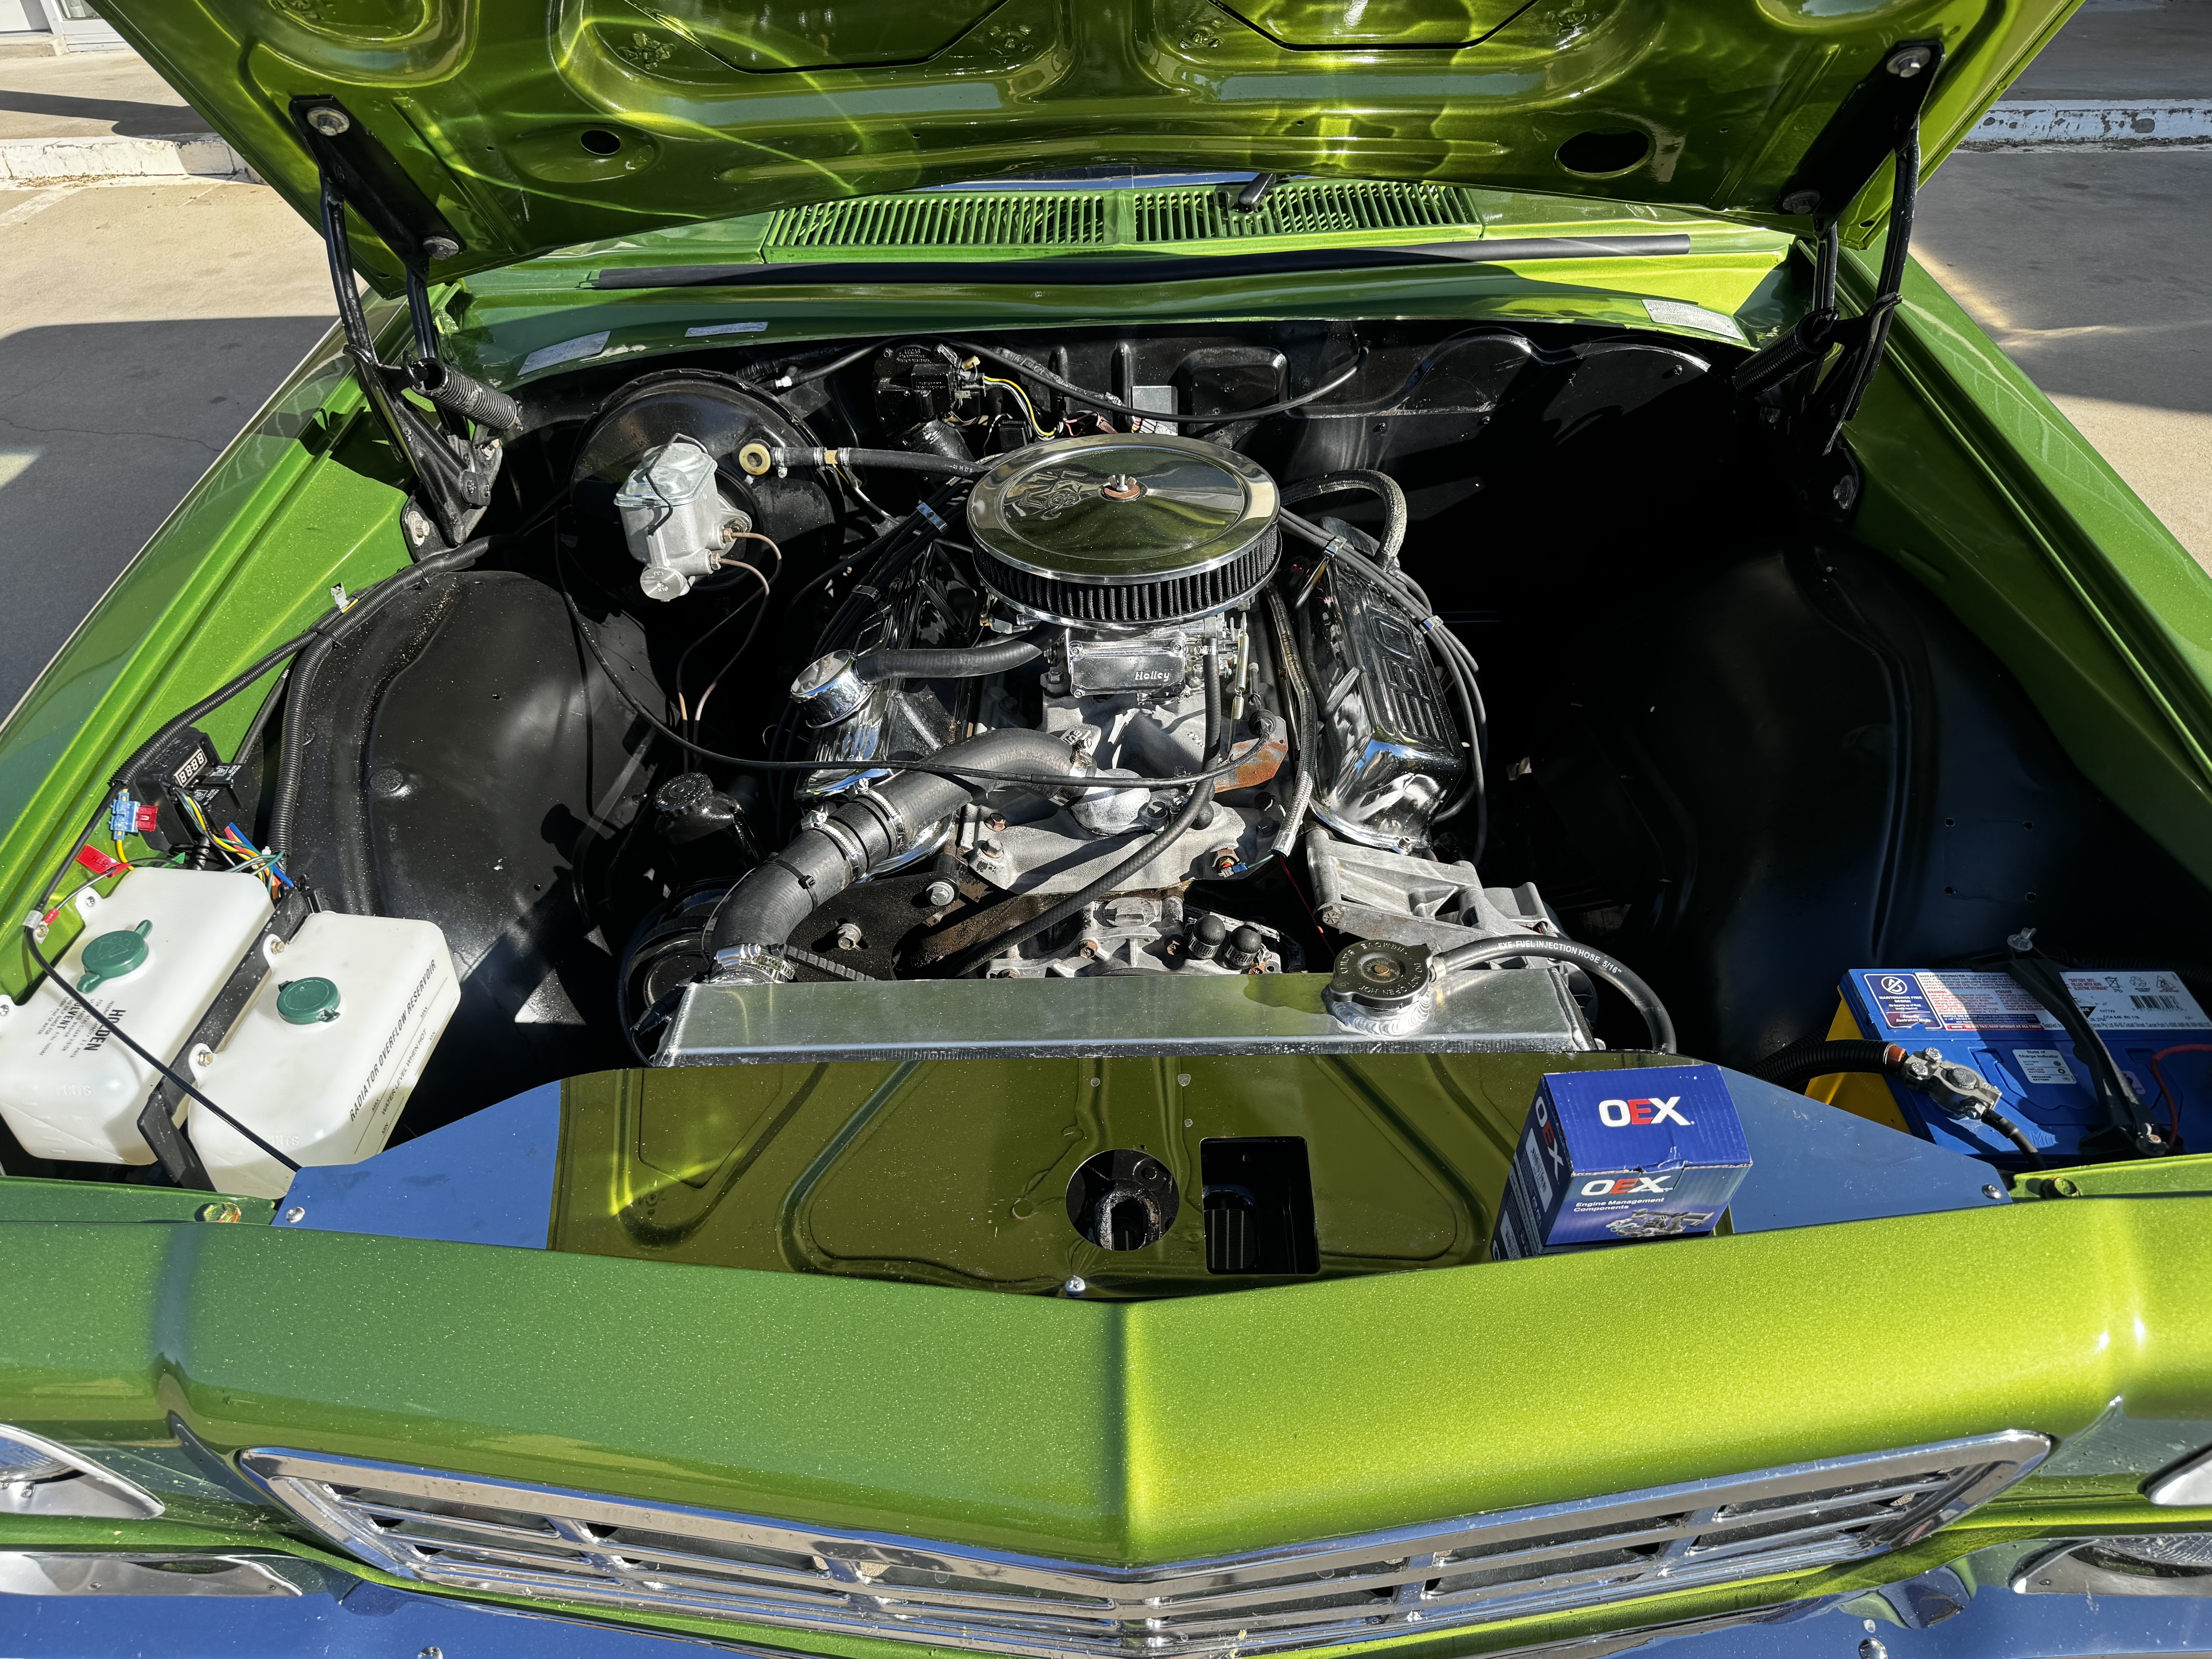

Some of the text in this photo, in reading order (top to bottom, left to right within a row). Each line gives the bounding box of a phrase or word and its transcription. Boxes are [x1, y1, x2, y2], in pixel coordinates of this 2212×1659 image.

[1135, 671, 1170, 682] Holley
[1536, 940, 1577, 955] INJECTION
[1578, 949, 1601, 963] HOSE
[1408, 975, 1421, 988] NOT
[1359, 986, 1379, 994] HOT
[1383, 986, 1407, 995] OPEN
[57, 1002, 82, 1030] OLVENT
[64, 1022, 78, 1037] WASHER
[73, 1025, 84, 1038] CLEAR
[350, 959, 436, 1121] RADIATOR OVERFLOW RESERVOIR
[382, 1028, 427, 1115] WATER LEVEL WHEN HOT
[372, 1097, 380, 1112] MAX
[1599, 1096, 1691, 1127] OEX
[1535, 1096, 1564, 1181] OEX
[1581, 1176, 1671, 1196] OEX
[1573, 1204, 1629, 1212] Components
[1608, 1197, 1664, 1206] Management
